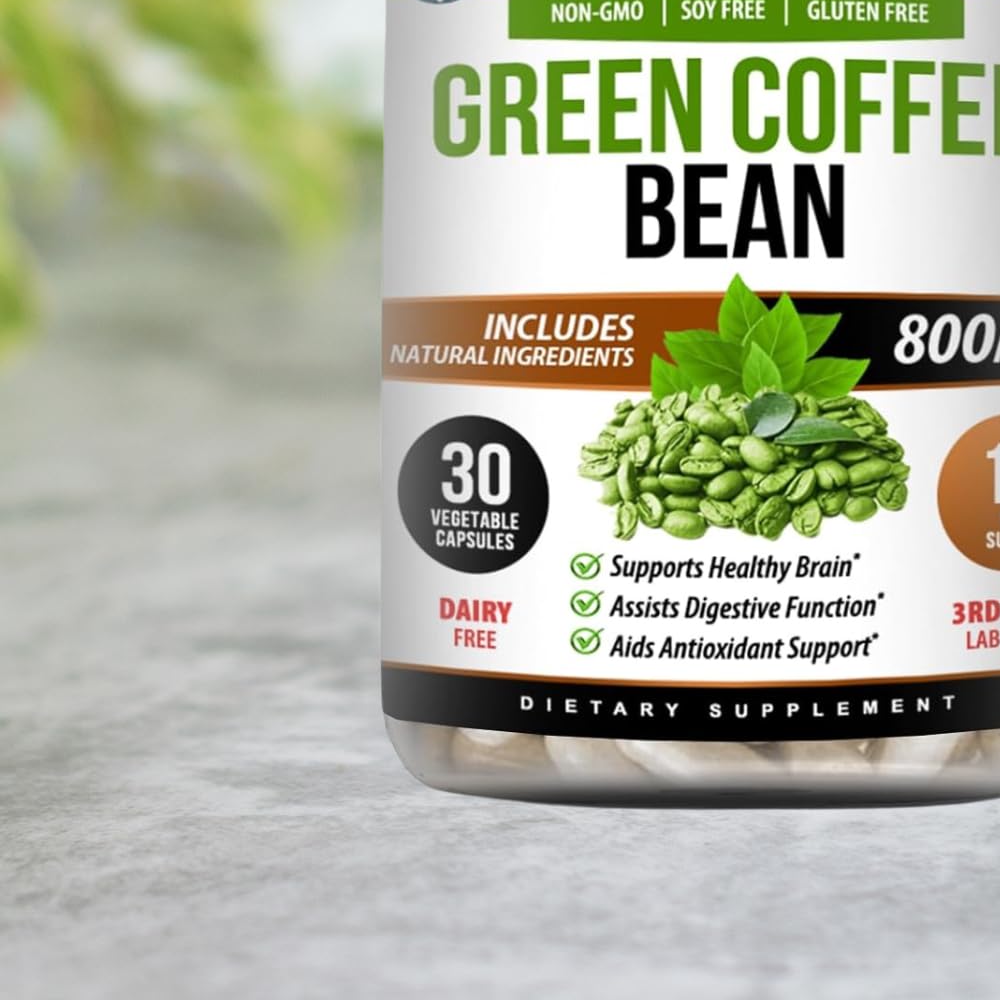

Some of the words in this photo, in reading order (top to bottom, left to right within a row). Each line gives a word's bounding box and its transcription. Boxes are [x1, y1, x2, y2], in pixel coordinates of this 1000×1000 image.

[551, 1, 644, 23] NON-GMO
[680, 0, 716, 20] SOY
[721, 0, 766, 20] FREE
[807, 0, 879, 21] GLUTEN
[885, 4, 929, 23] FREE
[433, 58, 702, 158] GREEN
[625, 163, 845, 259] BEAN
[484, 313, 635, 341] INCLUDES
[389, 344, 488, 366] NATURAL
[492, 346, 635, 368] INGREDIENTS
[441, 441, 511, 506] 30
[430, 508, 519, 530] VEGETABLE
[435, 529, 515, 551] CAPSULES
[610, 554, 703, 584] Supports
[708, 555, 791, 584] Healthy
[439, 597, 512, 624] DAIRY
[609, 595, 679, 618] Assists
[684, 596, 781, 625] Digestive
[952, 599, 1000, 625] 3RD
[454, 628, 497, 649] FREE
[609, 635, 655, 659] Aids
[659, 636, 783, 660] Antioxidant
[966, 630, 1000, 650] LAB
[520, 695, 679, 717] DIETARY
[709, 694, 956, 718] SUPPLEMENT
